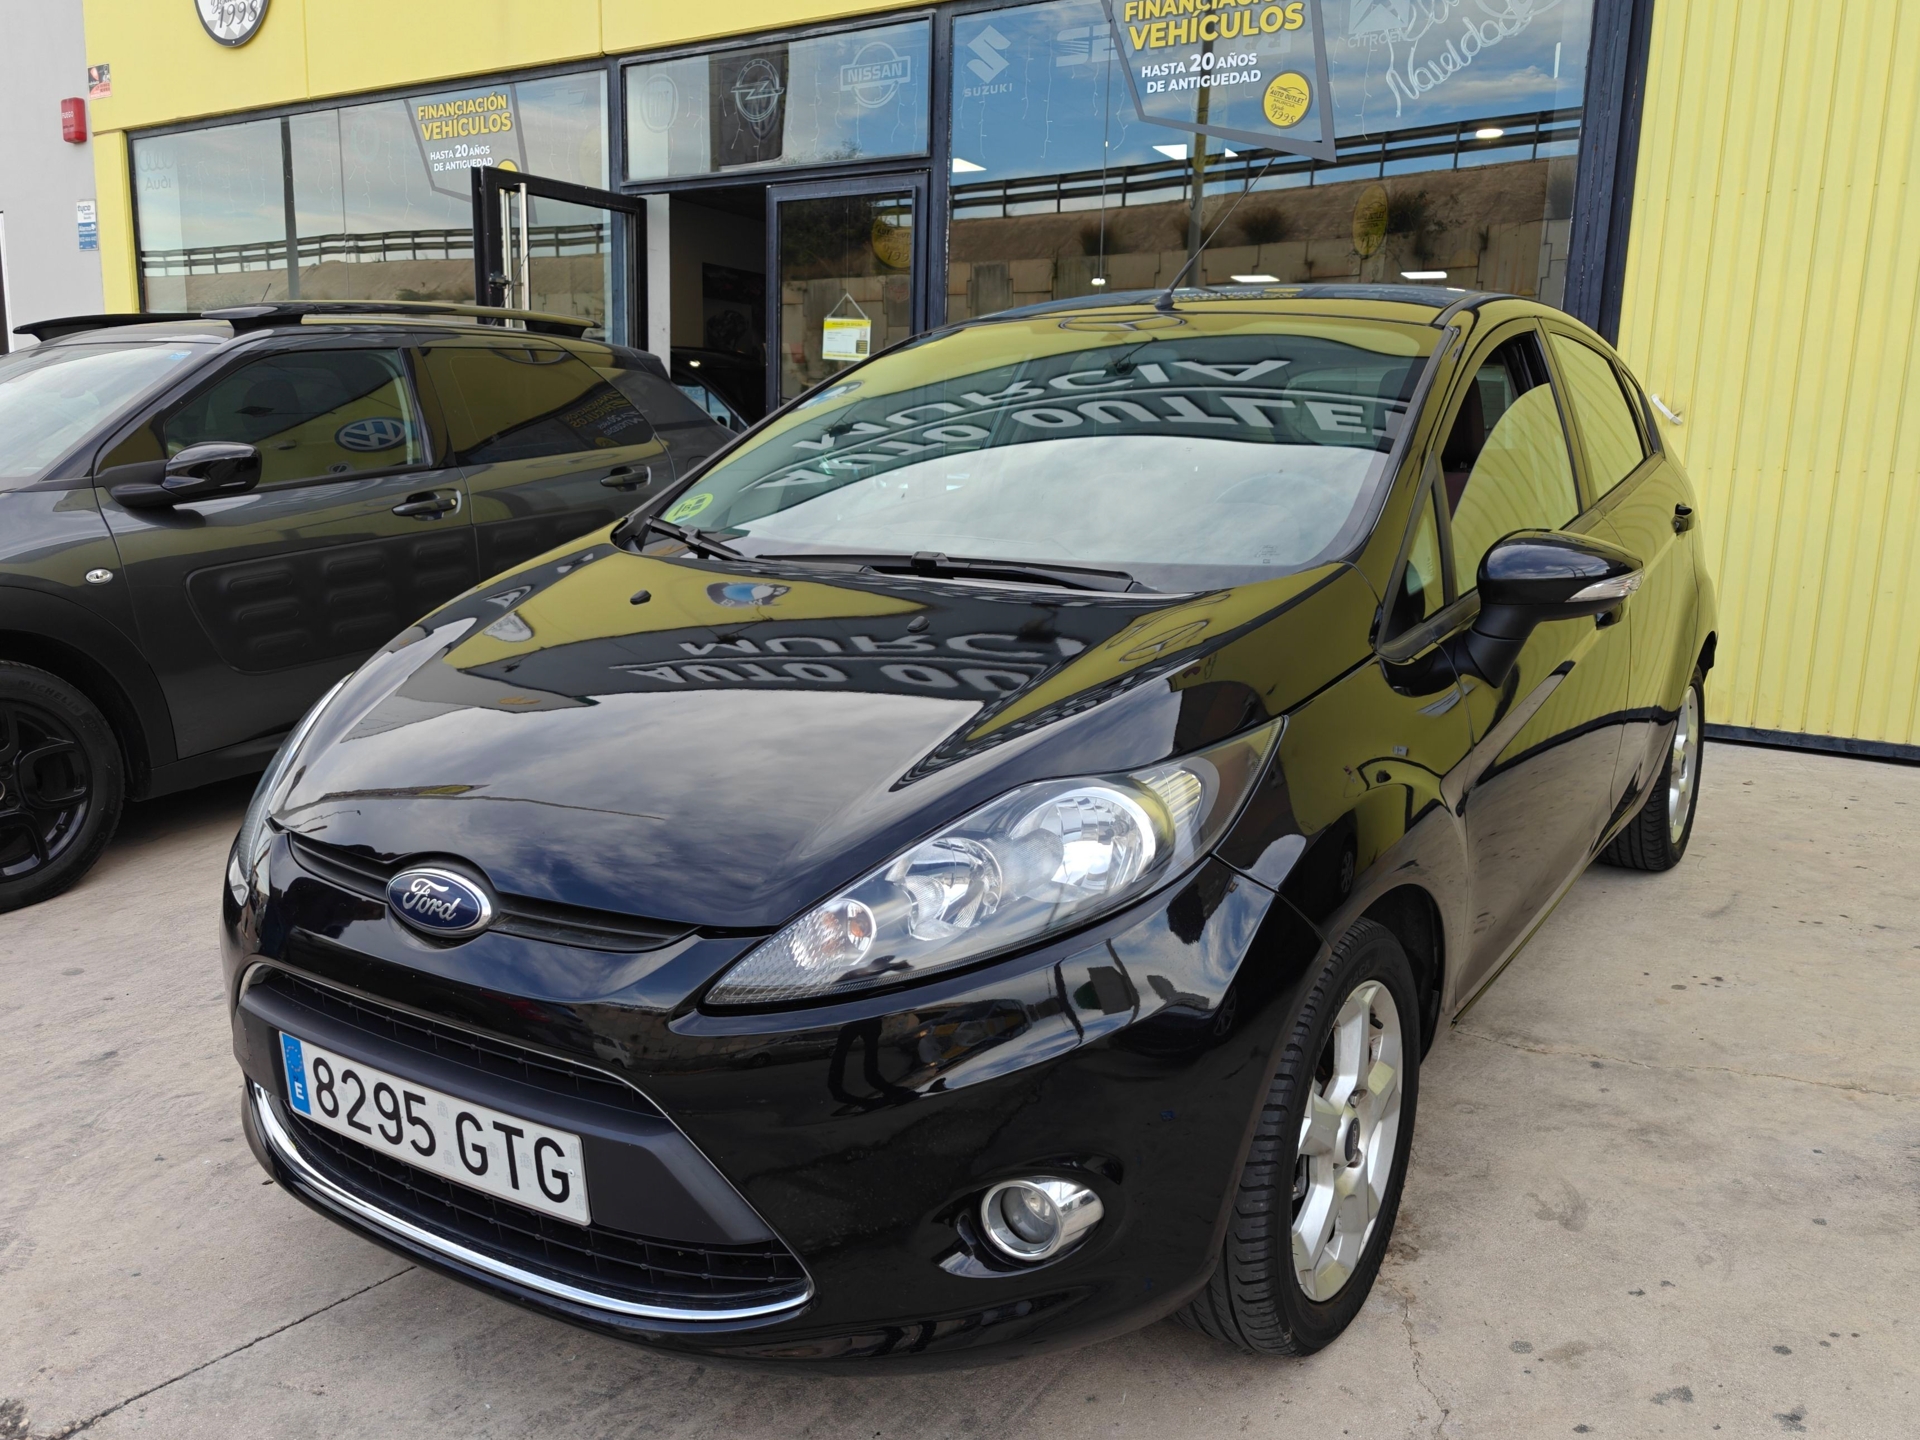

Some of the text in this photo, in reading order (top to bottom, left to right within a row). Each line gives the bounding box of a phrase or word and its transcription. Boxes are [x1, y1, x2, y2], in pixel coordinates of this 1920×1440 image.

[218, 0, 258, 29] 1998
[1128, 2, 1304, 51] VEHÍCULOS
[847, 62, 902, 83] NISSAN
[1141, 52, 1257, 78] HASTA 20 AÑOS
[963, 82, 1013, 97] SUZUKI
[1146, 69, 1262, 93] DE ANTIGUEDAD
[417, 91, 508, 121] FINANCIACIÓN
[421, 111, 512, 141] VEHÍCULOS
[430, 144, 490, 161] HASTA 20 AÑOS
[433, 162, 444, 172] DE
[402, 877, 461, 922] Ford
[294, 1080, 304, 1100] E
[312, 1056, 571, 1203] 8295 GTG
